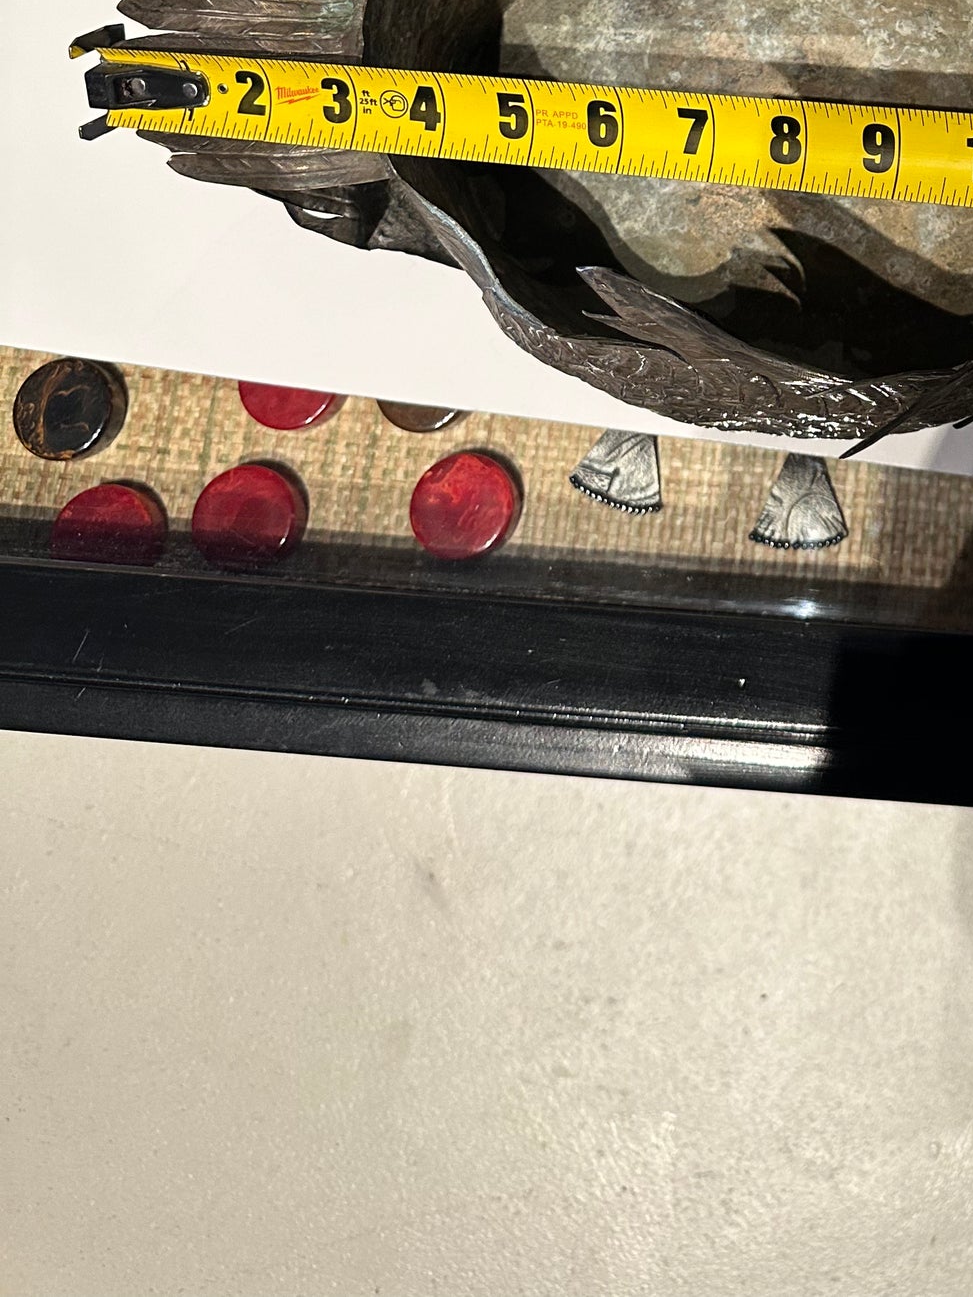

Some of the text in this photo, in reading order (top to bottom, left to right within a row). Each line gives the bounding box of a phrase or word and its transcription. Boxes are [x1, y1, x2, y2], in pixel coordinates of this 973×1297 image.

[235, 70, 267, 116] 2
[275, 85, 320, 101] Milwaukee
[320, 78, 352, 124] 3
[362, 106, 372, 115] in
[409, 85, 442, 132] 4
[496, 92, 529, 140] 5
[552, 111, 578, 120] APPD
[586, 99, 619, 148] 6
[677, 107, 709, 155] 7
[769, 115, 802, 166] 8
[862, 123, 896, 174] 9
